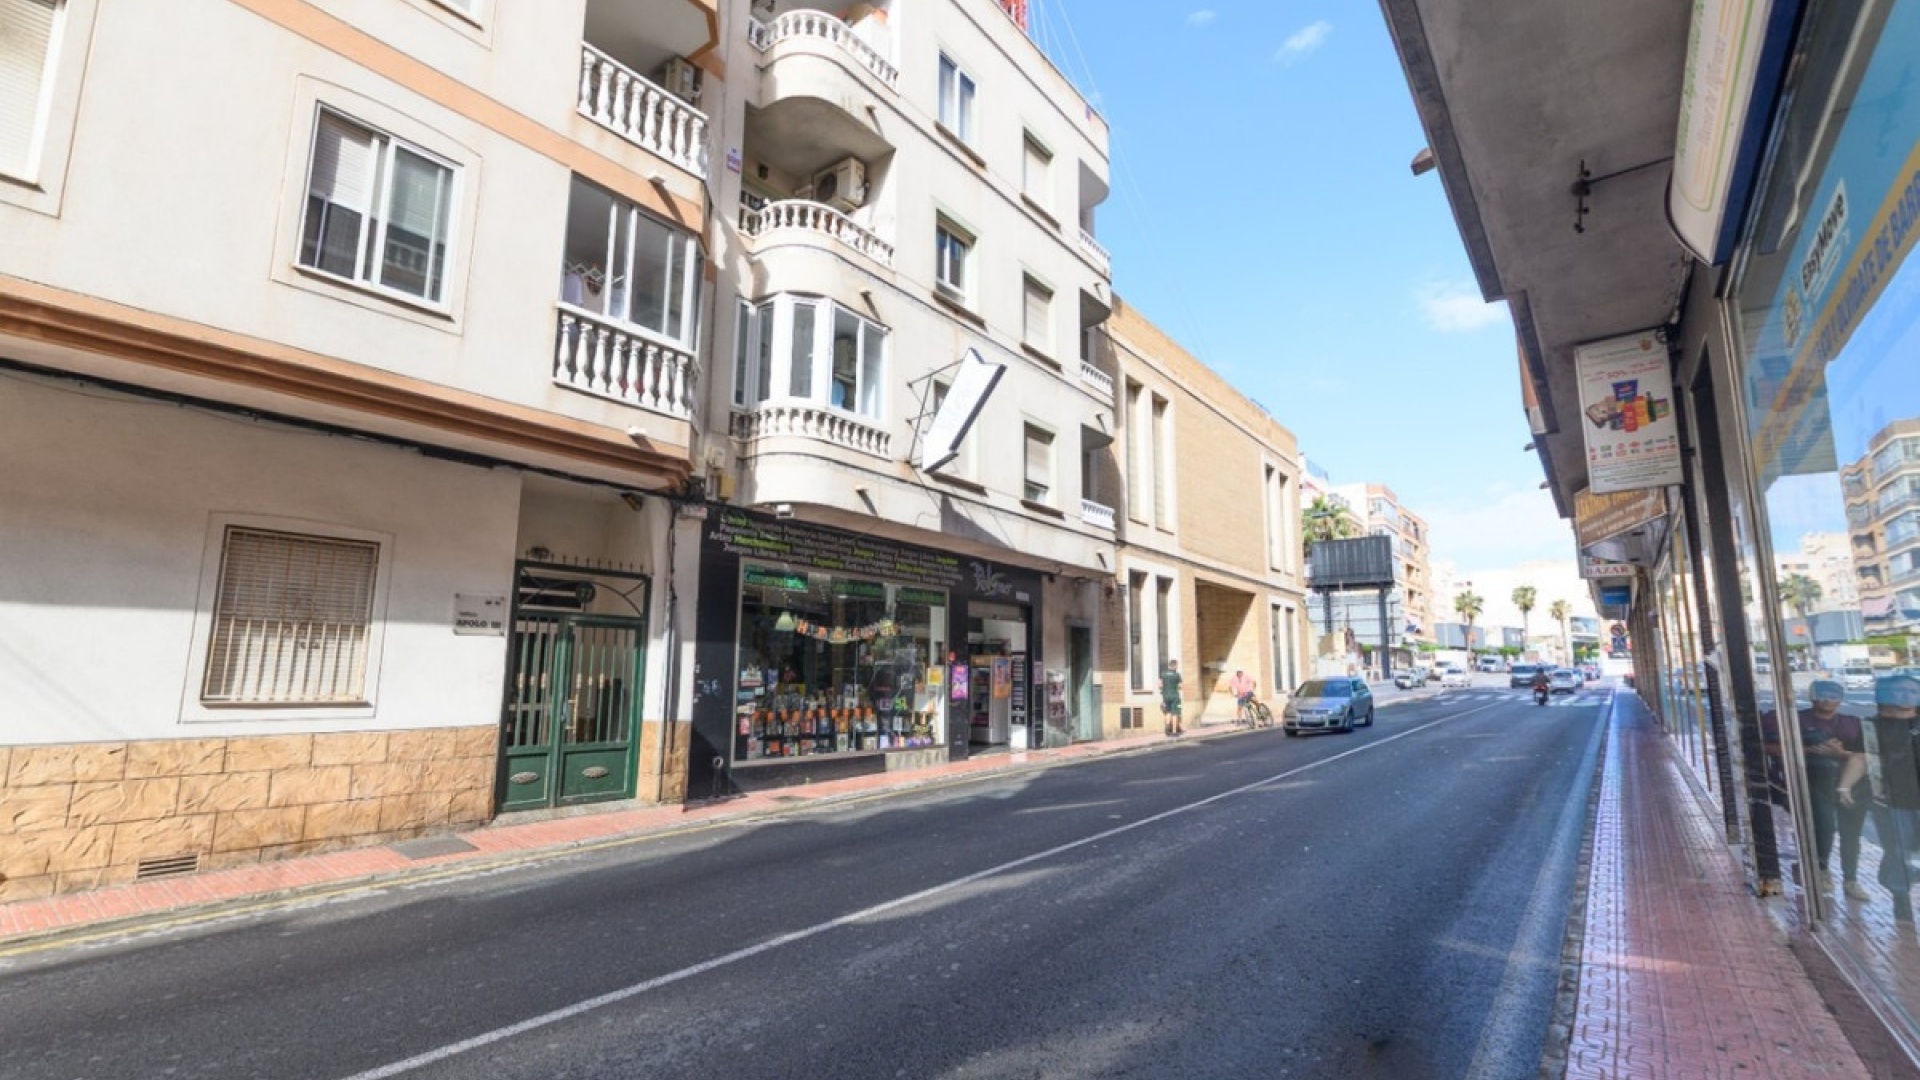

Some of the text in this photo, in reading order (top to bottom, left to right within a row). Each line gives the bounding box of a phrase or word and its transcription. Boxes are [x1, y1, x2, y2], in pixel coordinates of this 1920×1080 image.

[1802, 193, 1844, 291] EasyMove
[1585, 566, 1629, 575] BAZAR
[456, 619, 488, 628] APOLO
